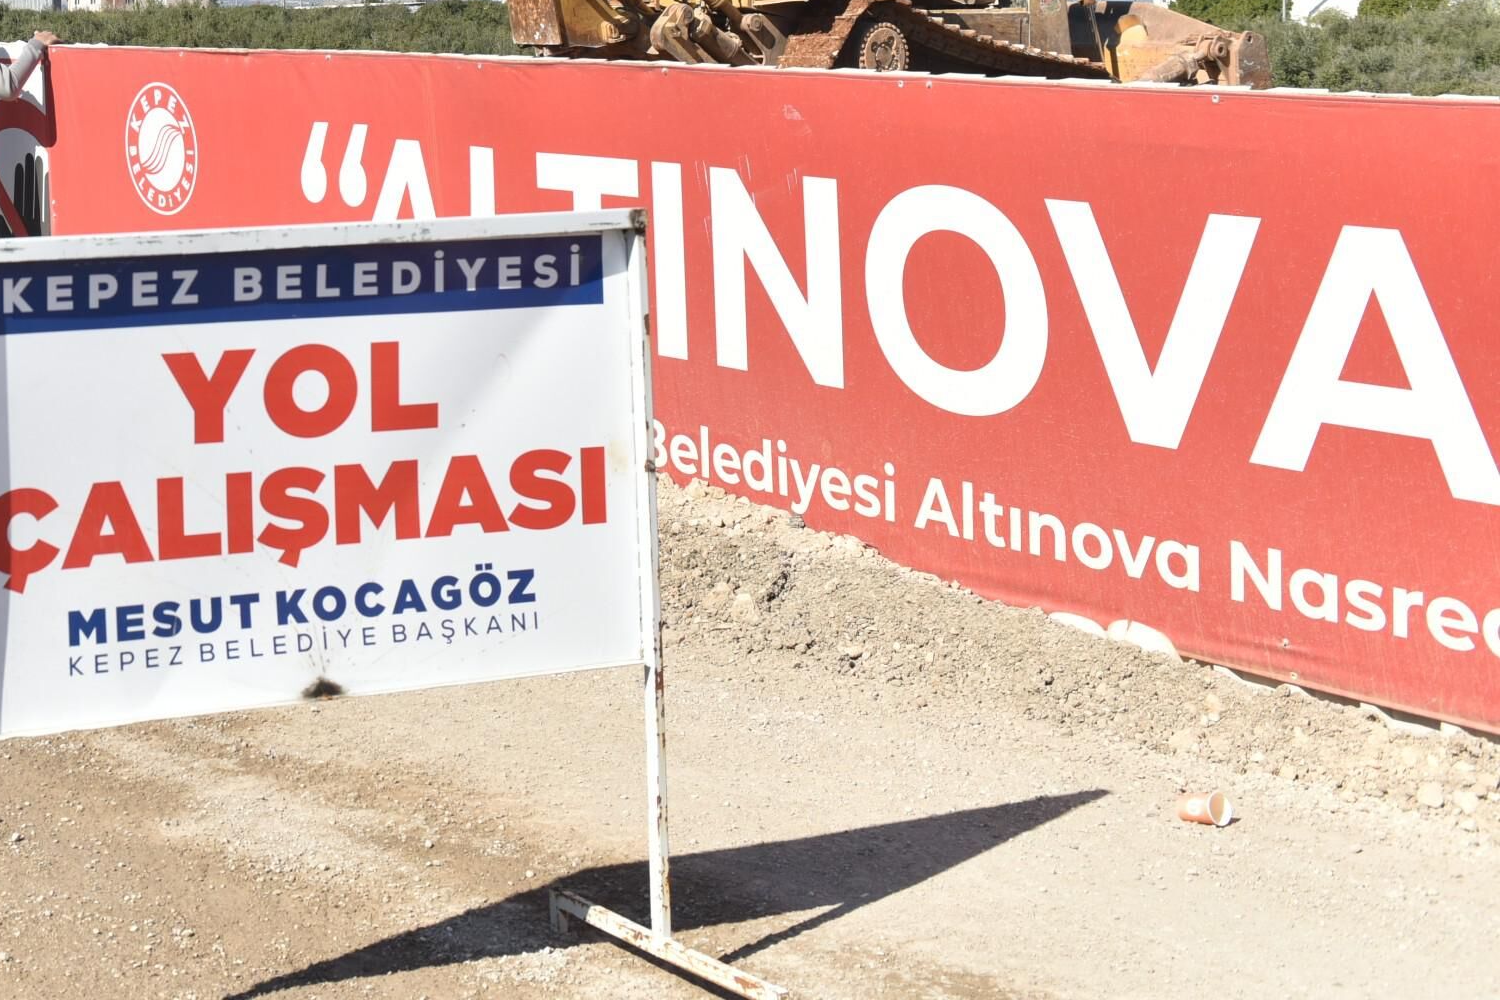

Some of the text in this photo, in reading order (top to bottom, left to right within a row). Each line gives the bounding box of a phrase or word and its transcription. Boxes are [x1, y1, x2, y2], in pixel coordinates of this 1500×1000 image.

[130, 88, 190, 134] KEPEZ
[2, 244, 581, 314] KEPEZ BELEDİYESİ
[161, 341, 439, 444] YOL
[913, 476, 1200, 592] Altınova
[68, 562, 536, 647] MESUT KOCAGÖZ
[69, 611, 538, 677] KEPEZ BELEDİYE BAŞKANI
